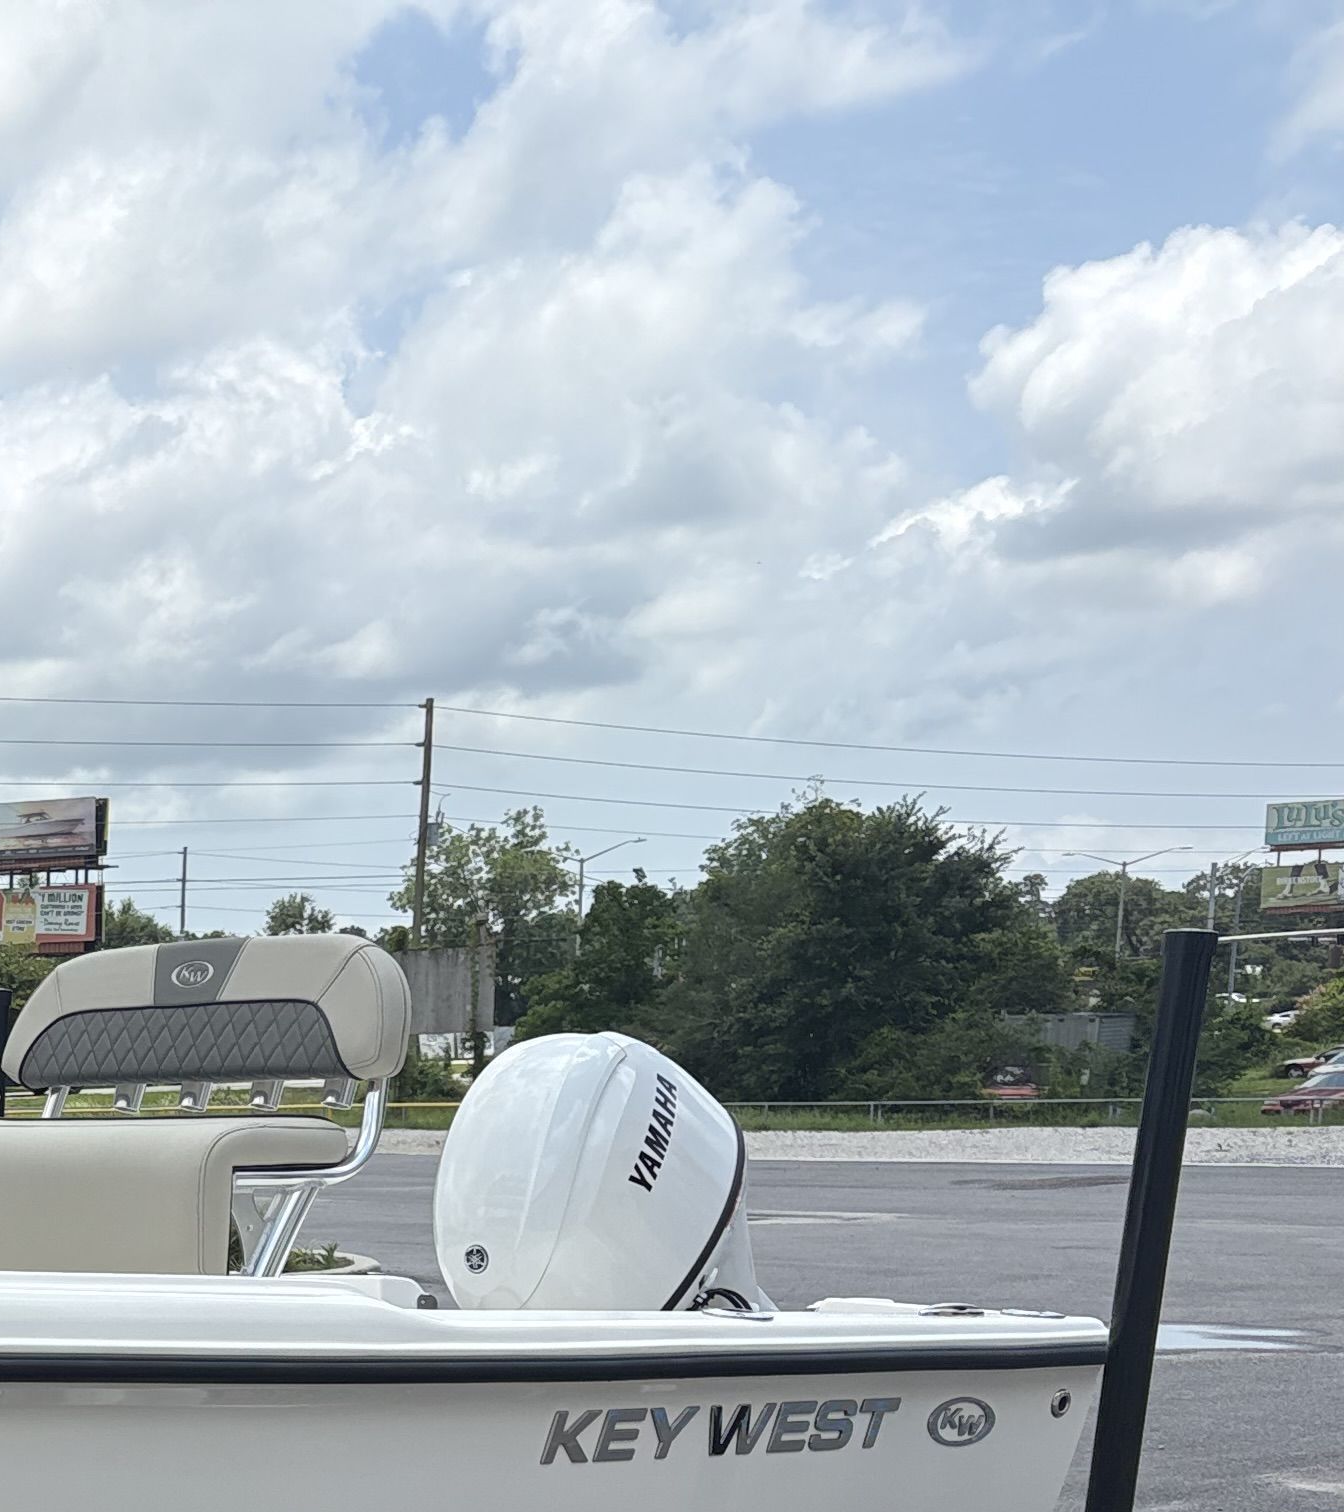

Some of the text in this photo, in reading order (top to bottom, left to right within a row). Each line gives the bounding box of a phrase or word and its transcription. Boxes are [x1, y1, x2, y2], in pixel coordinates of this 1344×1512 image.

[628, 1073, 677, 1192] YAMAHA
[539, 1397, 902, 1465] KEY WEST
